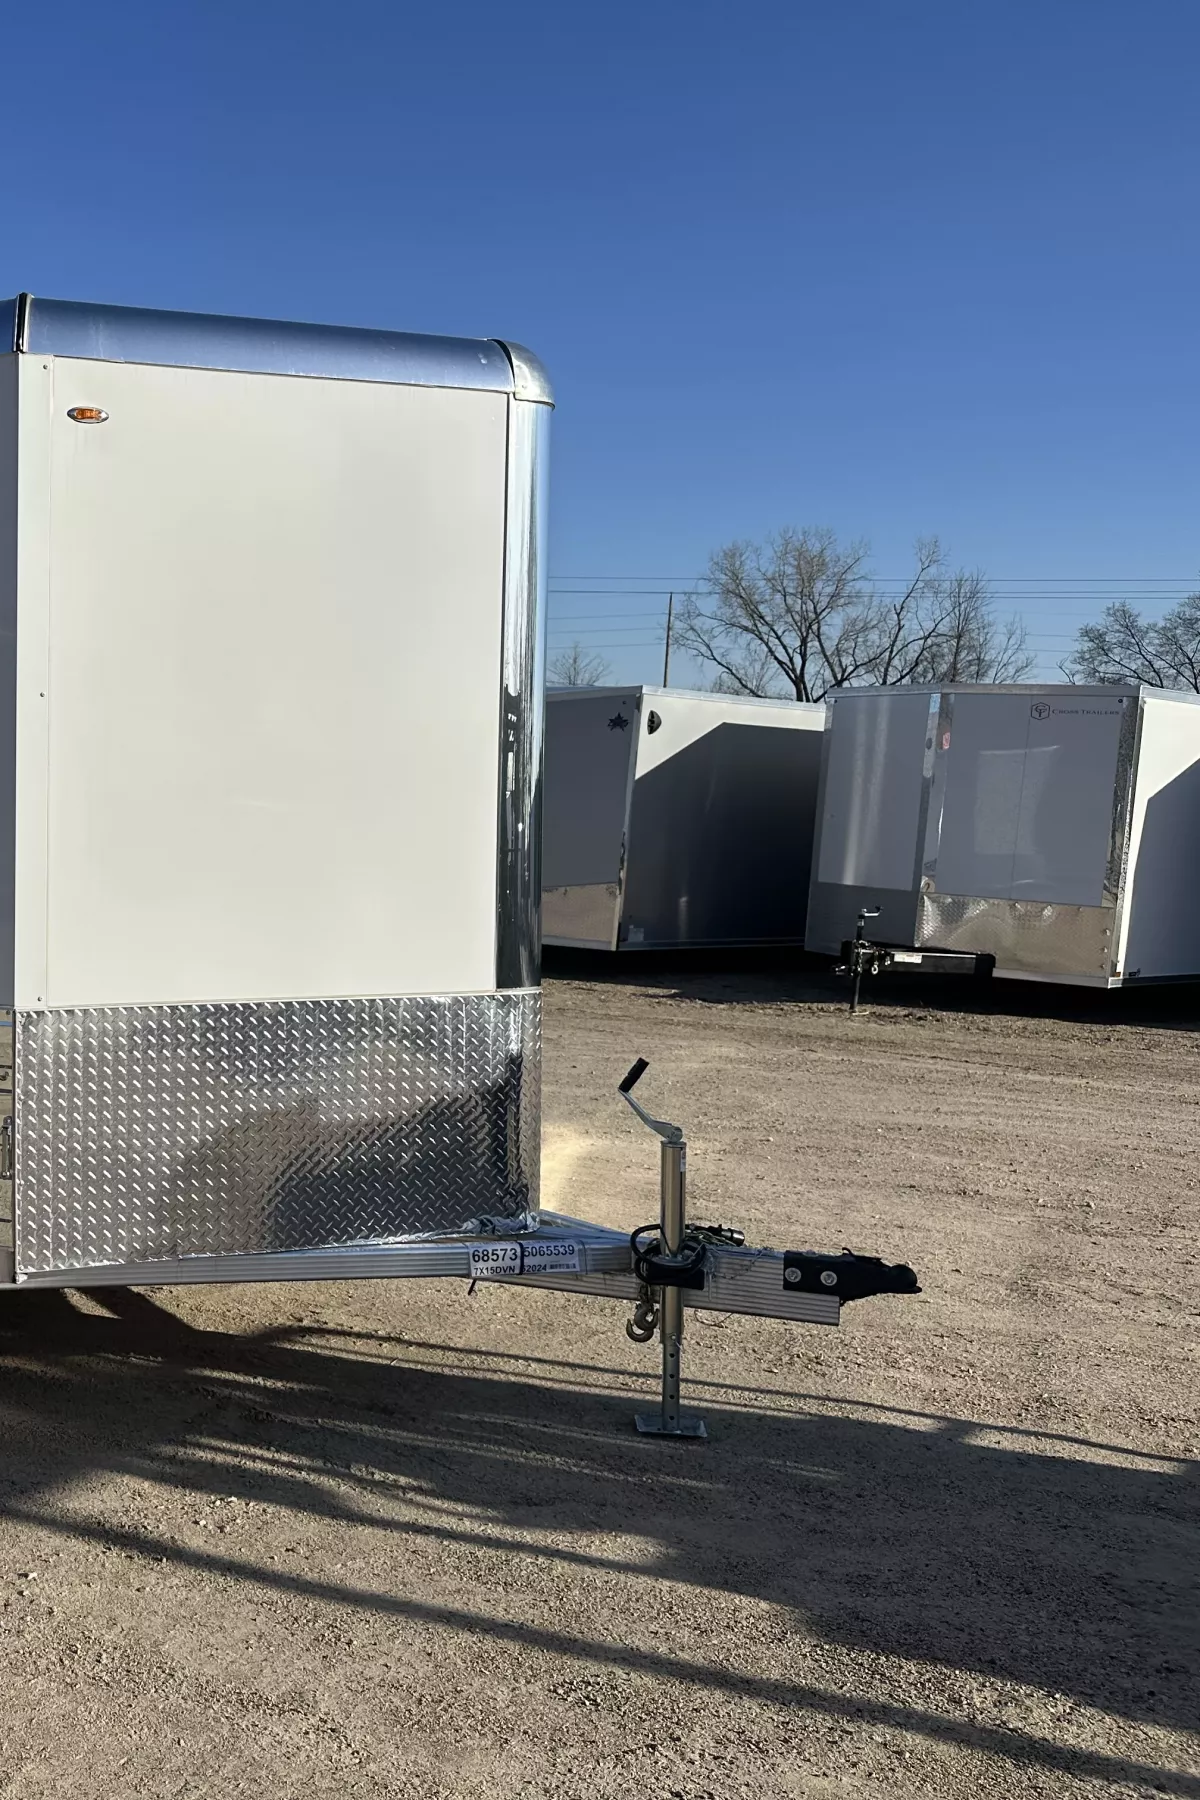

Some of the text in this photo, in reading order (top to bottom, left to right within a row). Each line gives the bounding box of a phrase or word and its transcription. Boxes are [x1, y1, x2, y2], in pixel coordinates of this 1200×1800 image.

[472, 1247, 518, 1263] 68573
[523, 1244, 575, 1258] 5065539
[473, 1265, 516, 1276] 7X15DVN
